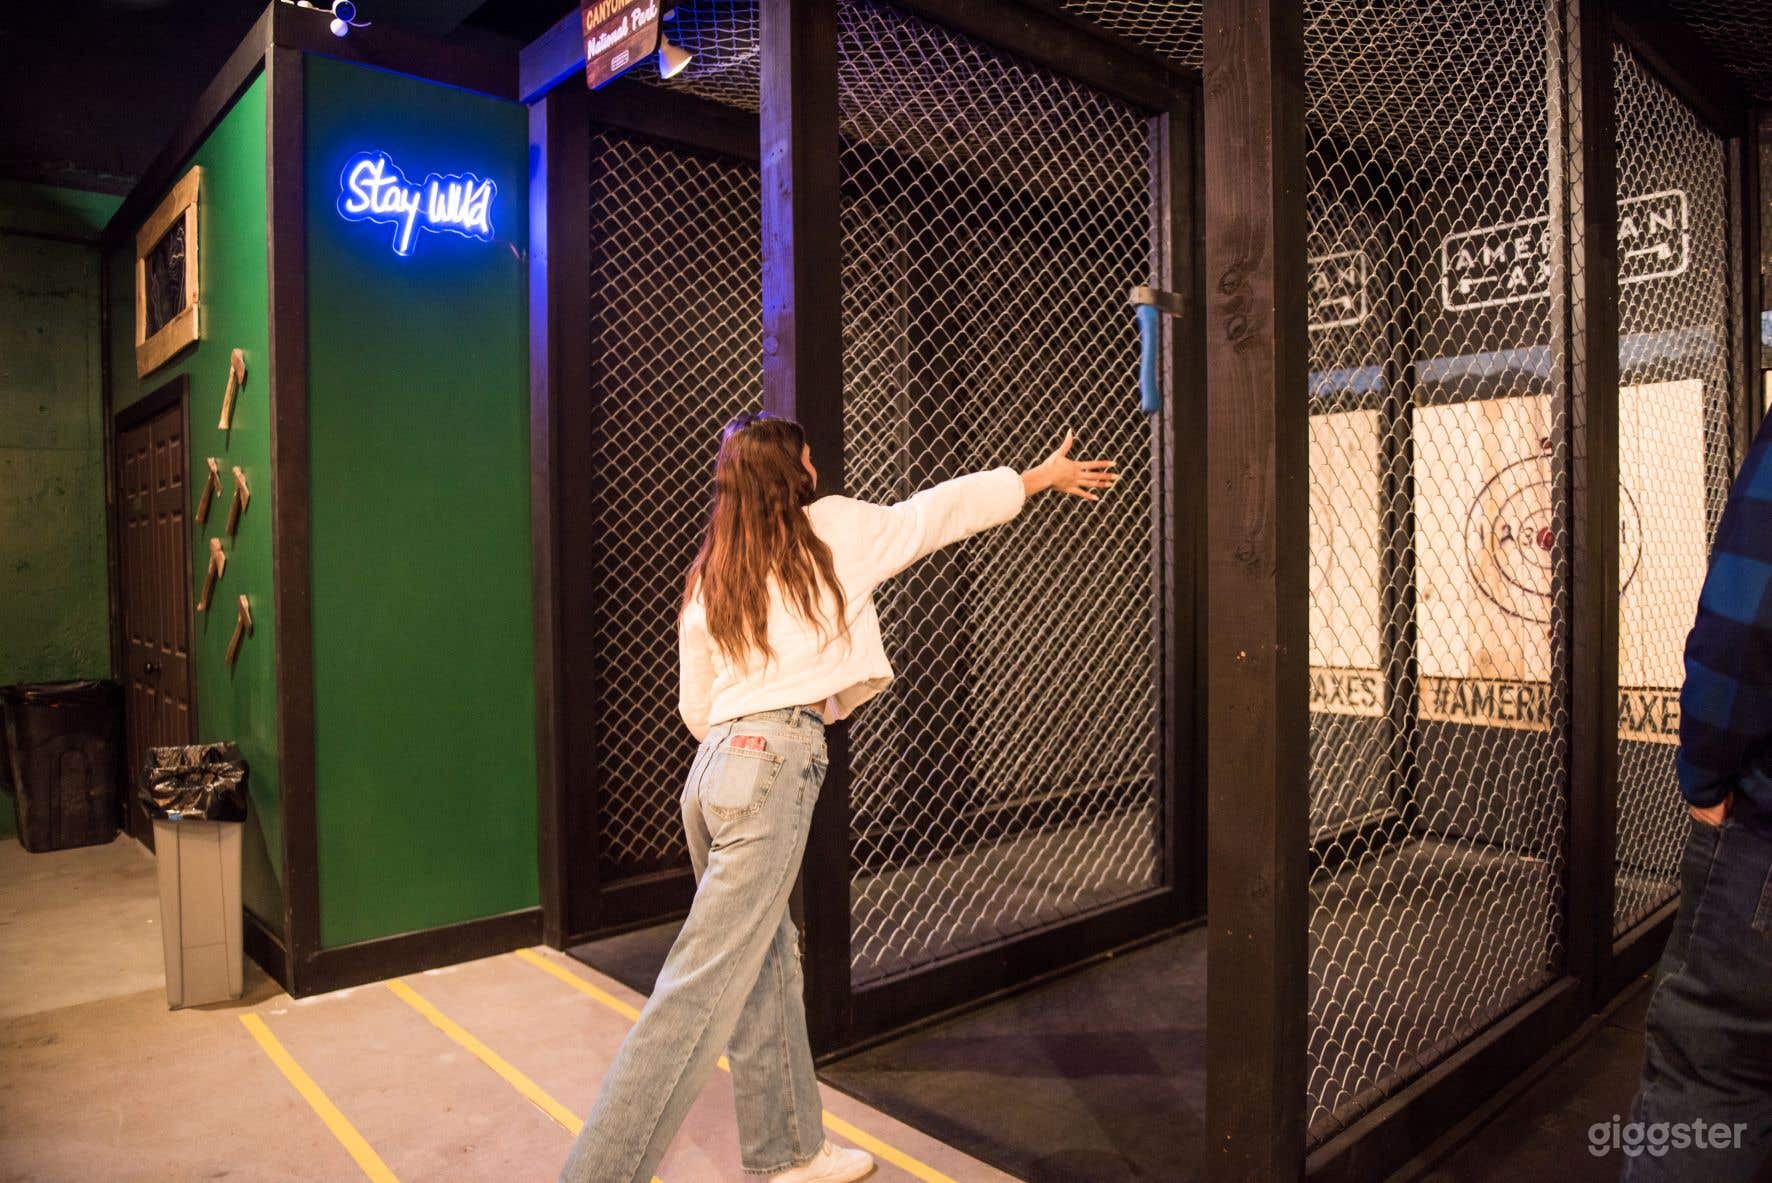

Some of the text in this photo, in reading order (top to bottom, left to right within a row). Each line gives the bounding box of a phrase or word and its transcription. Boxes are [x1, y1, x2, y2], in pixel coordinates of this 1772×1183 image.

[587, 0, 658, 60] National Park
[345, 158, 421, 252] Stay
